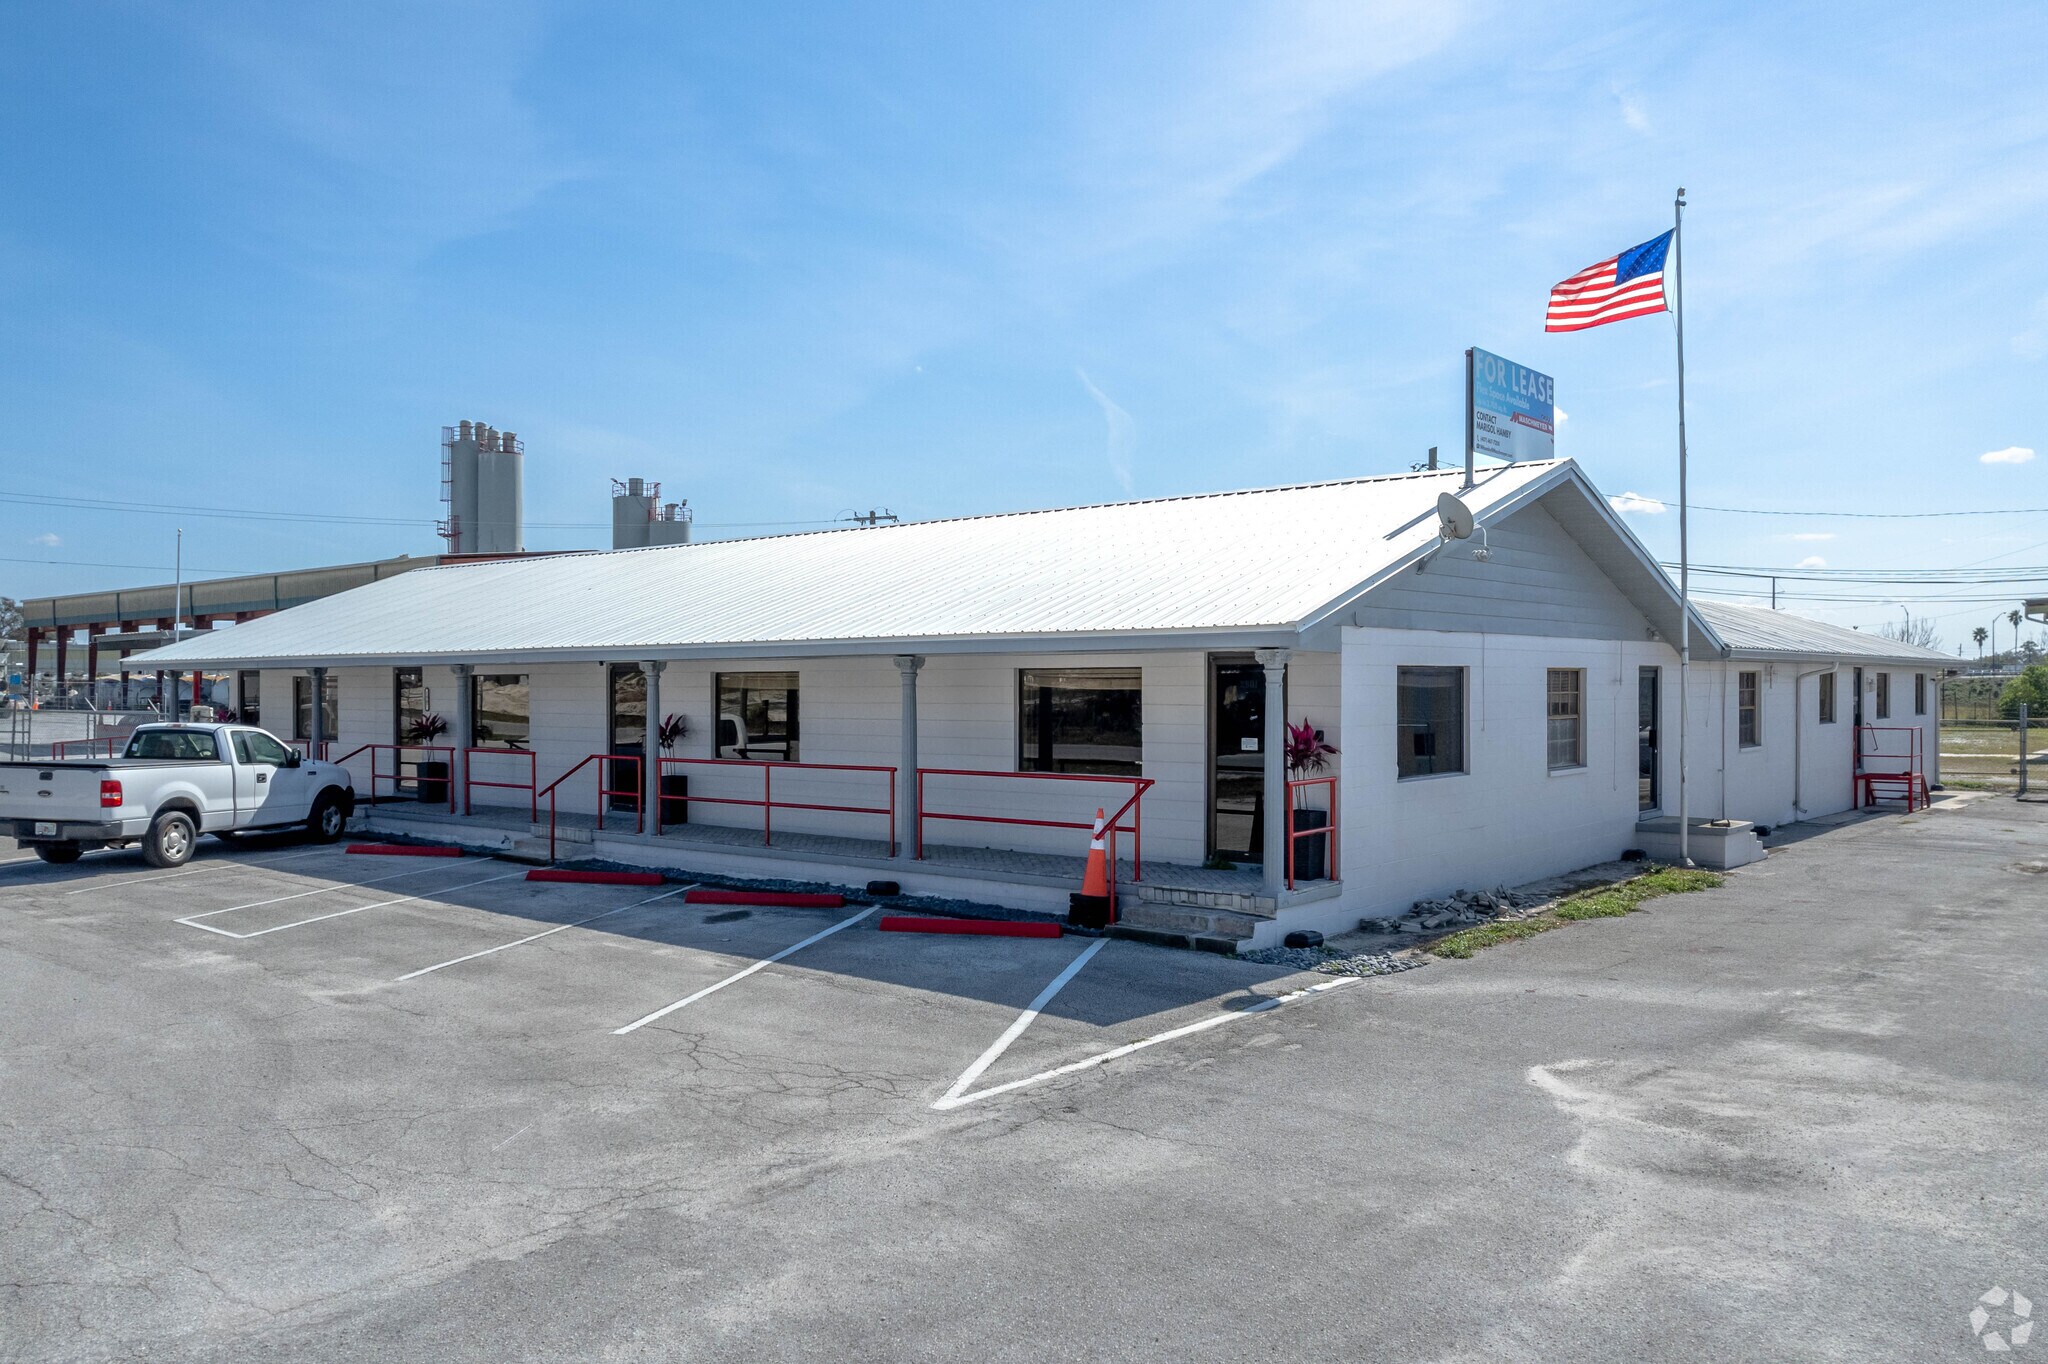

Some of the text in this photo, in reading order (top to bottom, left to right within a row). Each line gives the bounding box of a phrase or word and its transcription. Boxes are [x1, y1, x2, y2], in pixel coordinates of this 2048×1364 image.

[1476, 352, 1506, 388] FOR
[1512, 365, 1553, 405] LEASE
[1476, 411, 1497, 425] CONTACT
[1476, 421, 1496, 435] MARISOL
